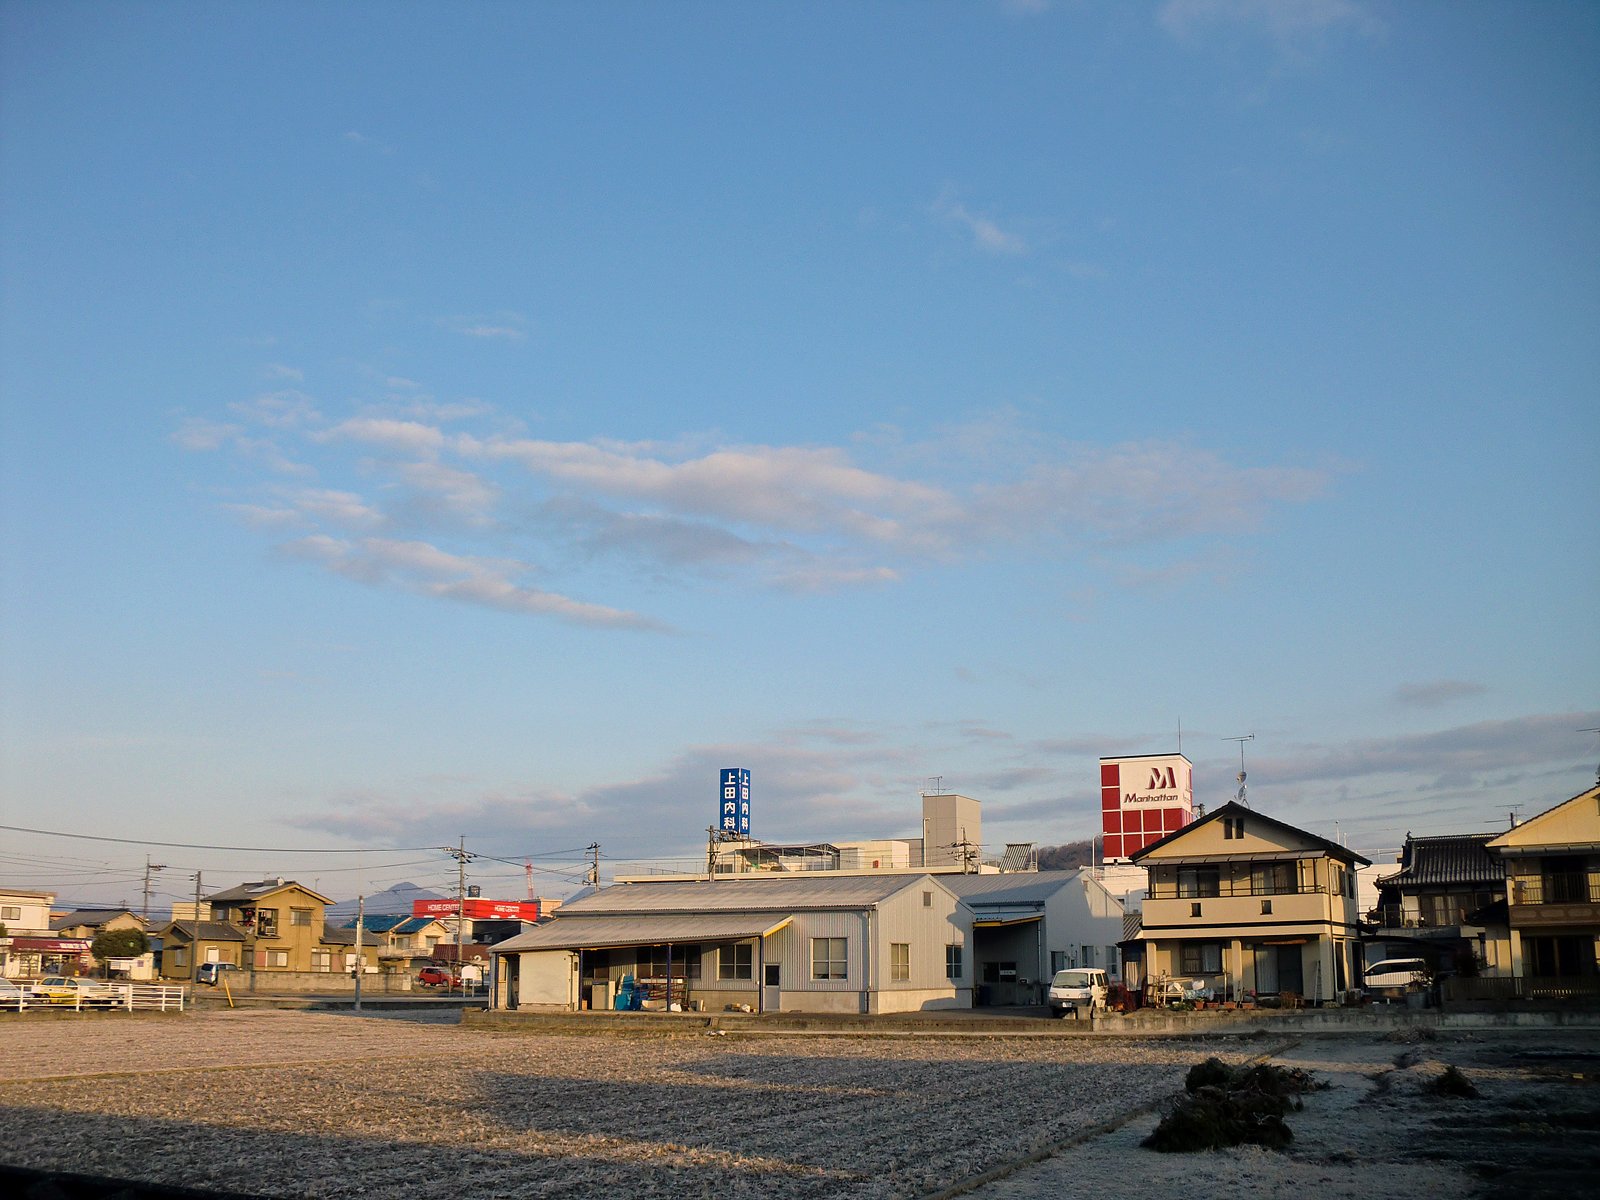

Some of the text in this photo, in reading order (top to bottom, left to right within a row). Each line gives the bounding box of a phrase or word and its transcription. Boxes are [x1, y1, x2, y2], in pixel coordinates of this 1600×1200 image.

[724, 772, 736, 829] 上田内科
[741, 773, 749, 830] 上田内科
[1123, 793, 1179, 804] Manhattan
[427, 904, 442, 912] HOME
